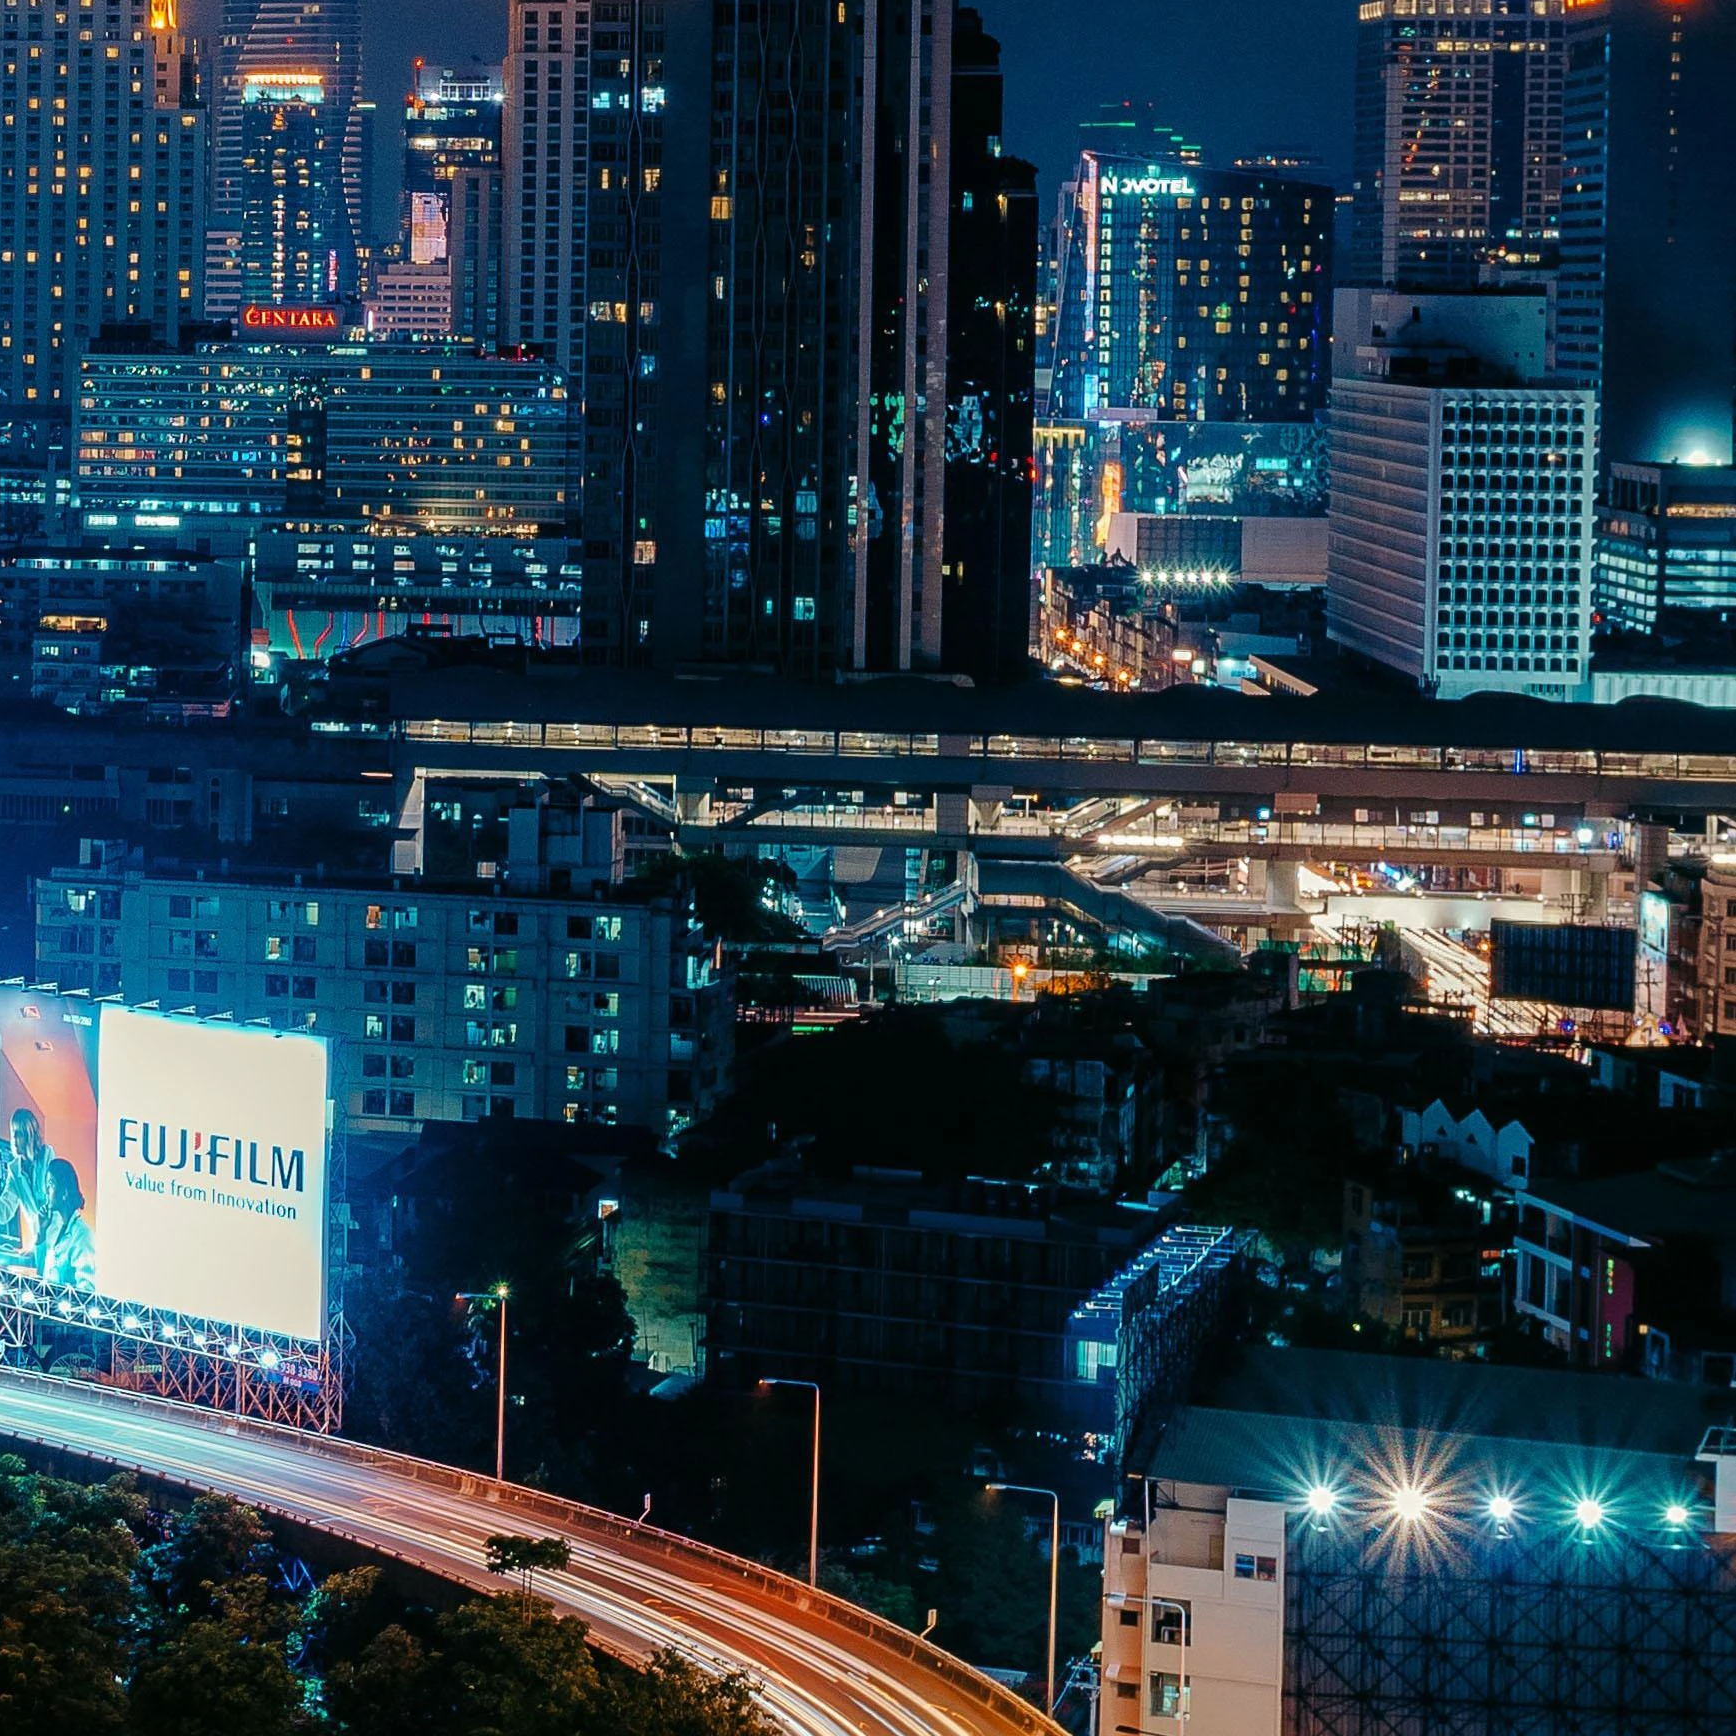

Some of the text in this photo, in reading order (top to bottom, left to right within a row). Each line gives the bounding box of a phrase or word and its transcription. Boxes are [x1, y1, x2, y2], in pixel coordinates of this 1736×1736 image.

[1100, 174, 1196, 195] NOVOTEL
[245, 304, 336, 326] CENTARA
[119, 1117, 304, 1193] FUJIFILM
[125, 1170, 297, 1221] Value from Innovation
